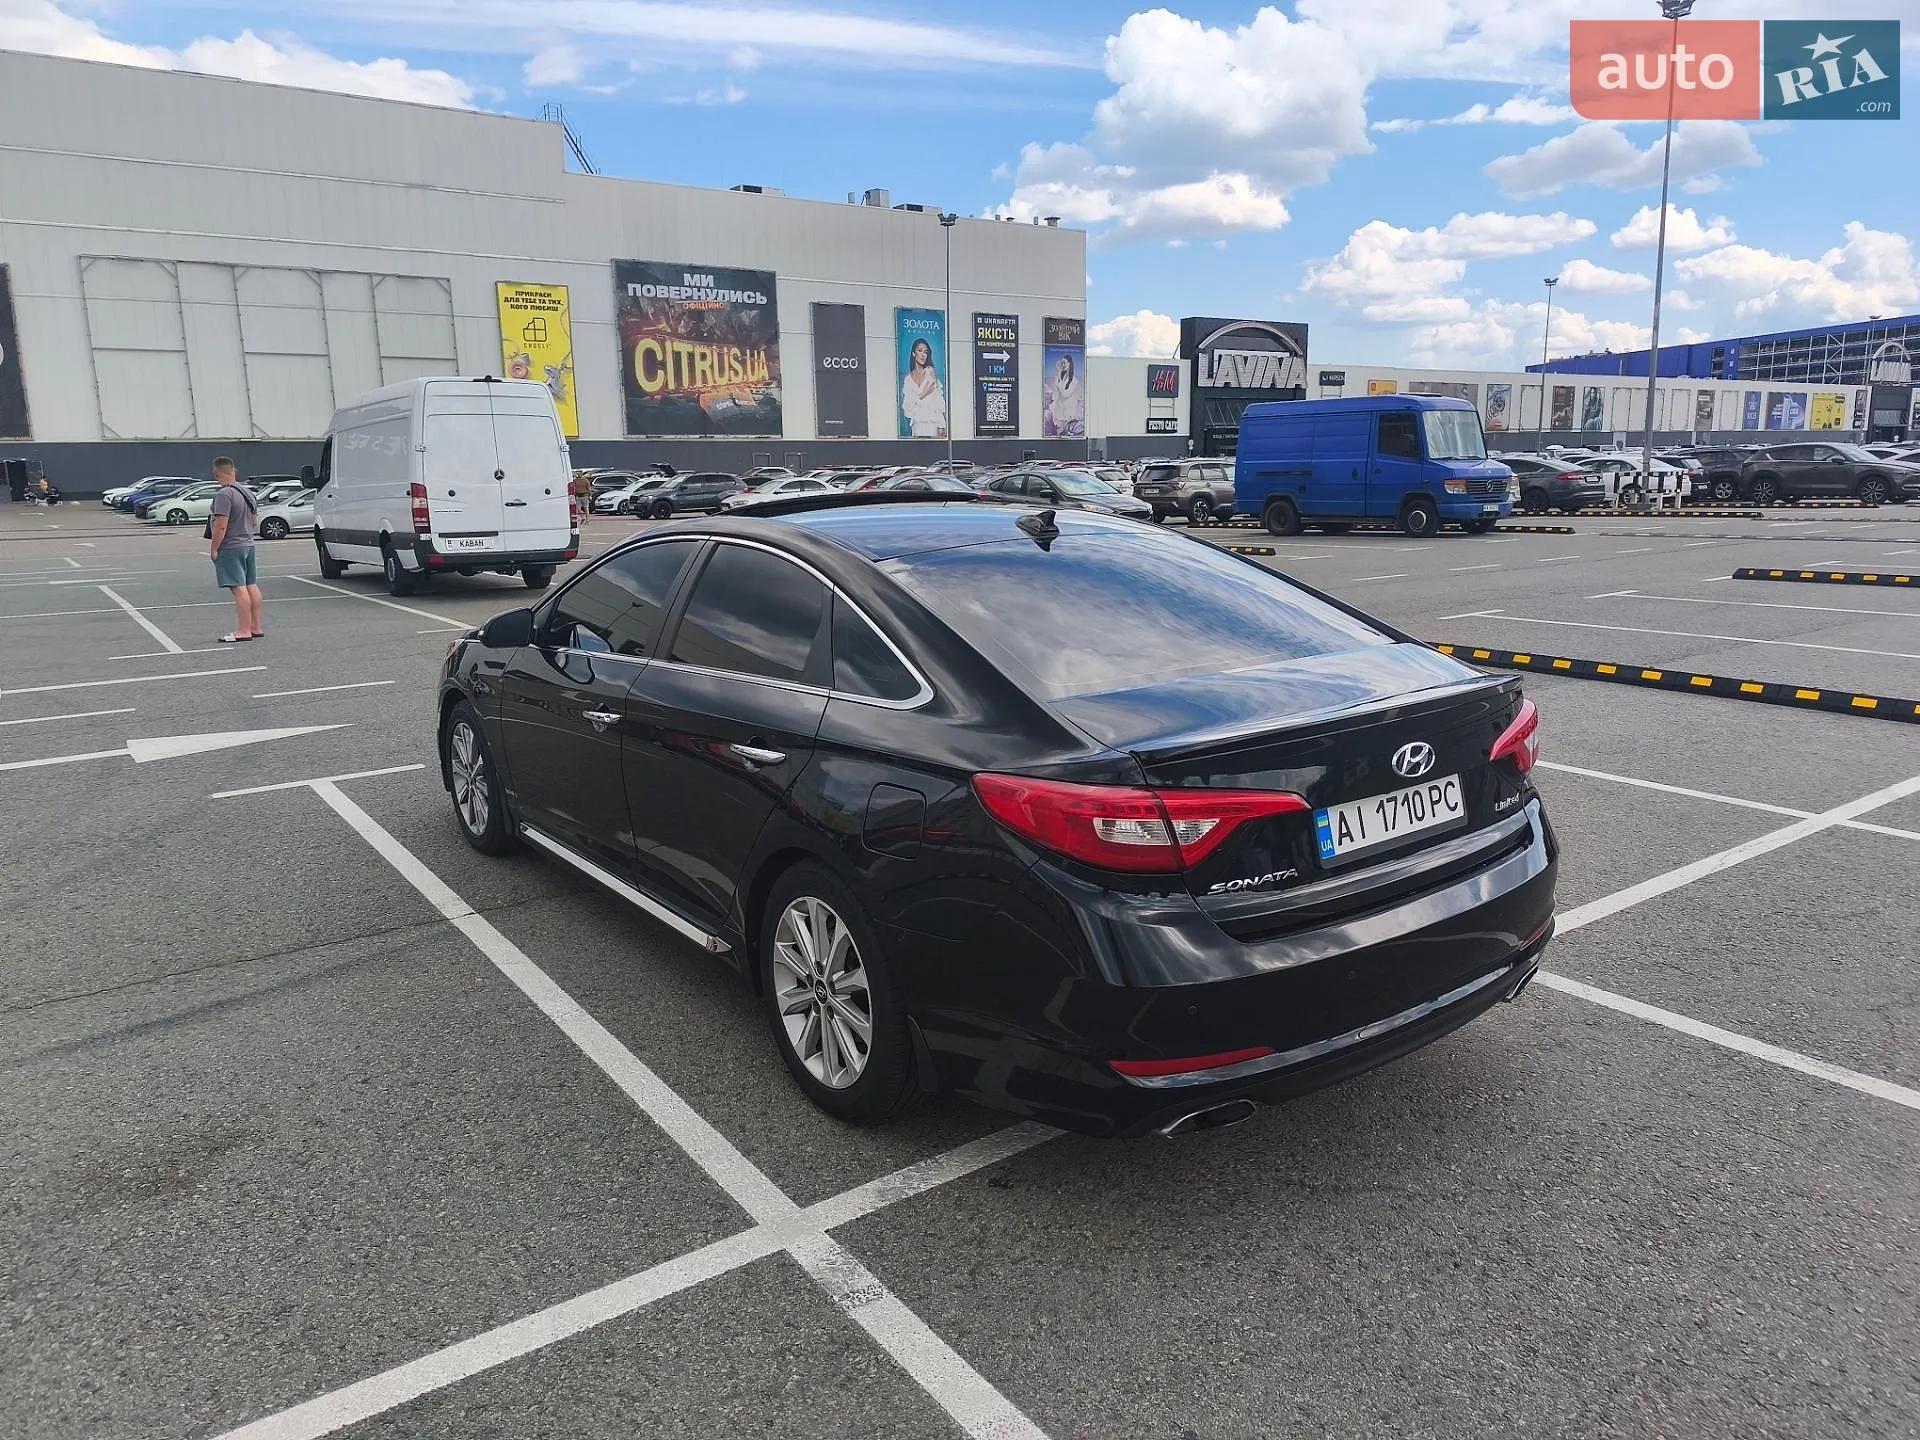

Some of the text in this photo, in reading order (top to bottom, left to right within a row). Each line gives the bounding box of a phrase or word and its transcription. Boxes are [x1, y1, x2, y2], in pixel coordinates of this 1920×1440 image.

[683, 273, 714, 287] МИ
[627, 283, 768, 305] ПОВЕРНУЛИСЬ
[903, 318, 940, 330] ЗОЛОТА
[977, 328, 1016, 340] ЯКІСТЬ
[635, 338, 769, 392] CITRUS.UA
[823, 357, 858, 369] ecco
[1198, 353, 1308, 388] LAVINA
[460, 540, 484, 548] KABAN
[1337, 780, 1459, 847] AI 1710 PC
[1320, 839, 1334, 852] UA
[1207, 868, 1298, 895] SONATA
